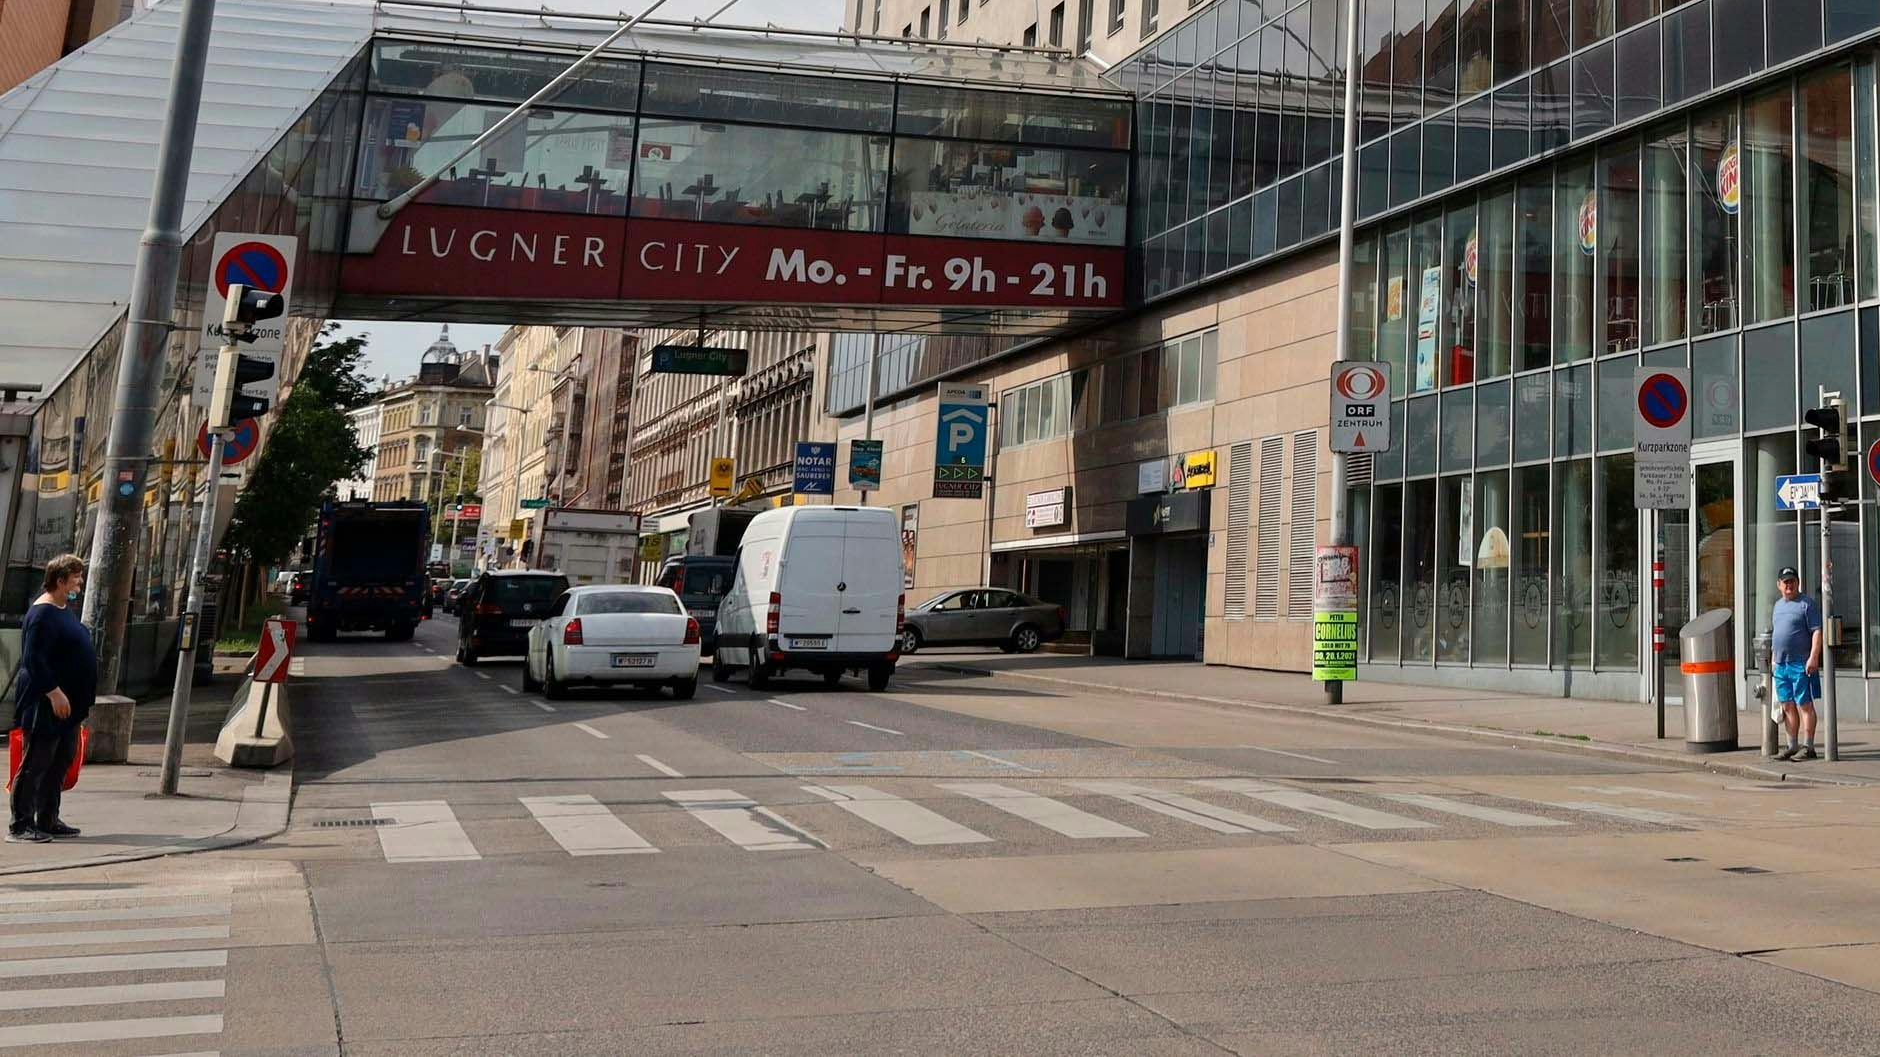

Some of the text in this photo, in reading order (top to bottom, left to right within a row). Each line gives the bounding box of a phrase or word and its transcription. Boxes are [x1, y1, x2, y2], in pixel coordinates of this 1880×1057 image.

[402, 225, 605, 268] LUGNER
[640, 241, 740, 275] CITY
[765, 247, 846, 286] Mo.
[885, 254, 933, 290] Fr.
[943, 256, 996, 293] 9h
[1029, 262, 1107, 299] 21h
[1347, 406, 1373, 415] ORF
[1337, 420, 1383, 428] ZENTRUM
[949, 423, 974, 452] P
[1638, 442, 1688, 454] Kurzparkzone
[797, 456, 832, 466] NOTAR
[1315, 623, 1356, 640] CORNELIUS
